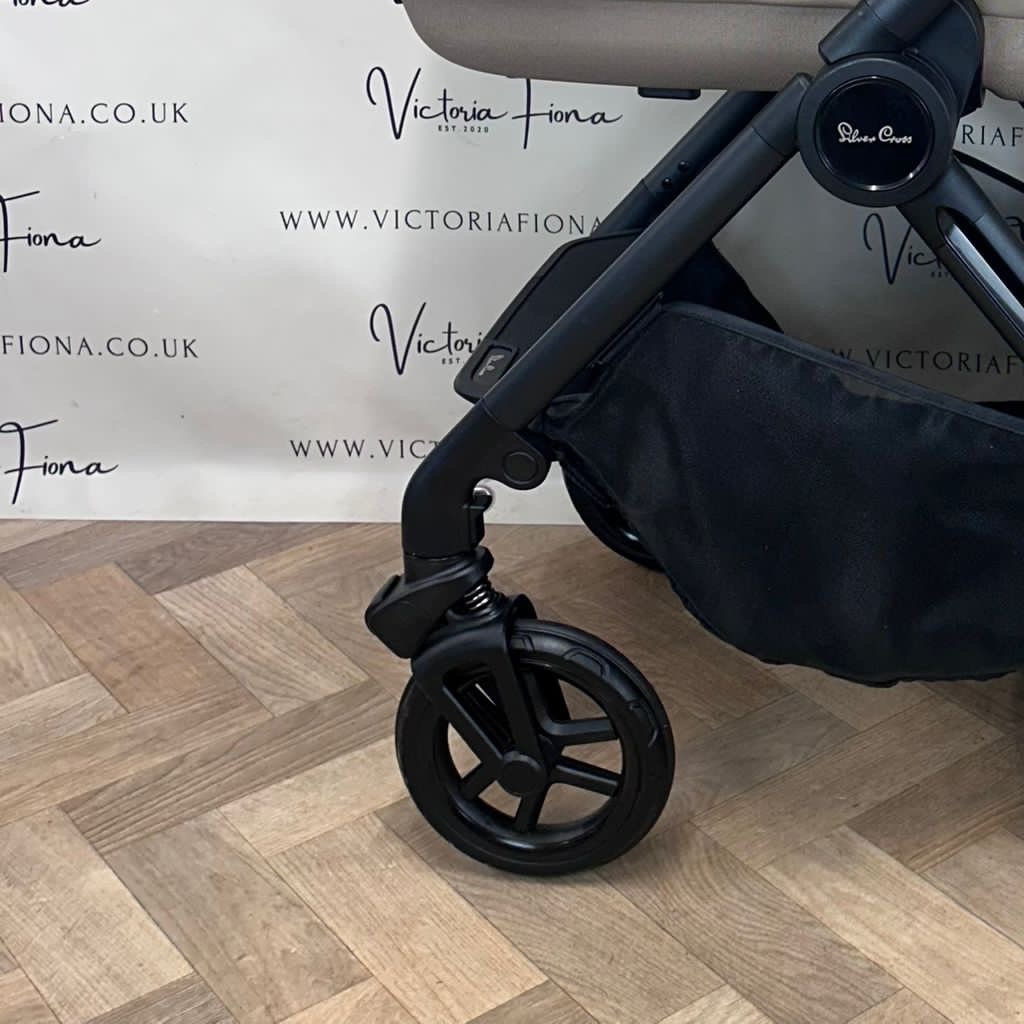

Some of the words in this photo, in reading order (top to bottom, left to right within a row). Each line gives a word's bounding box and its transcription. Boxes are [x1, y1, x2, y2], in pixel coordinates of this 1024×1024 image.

[366, 66, 508, 140] Victoria
[838, 121, 876, 144] Silver
[2, 335, 198, 358] FIONA.CO.UK
[0, 419, 119, 505] Fiona
